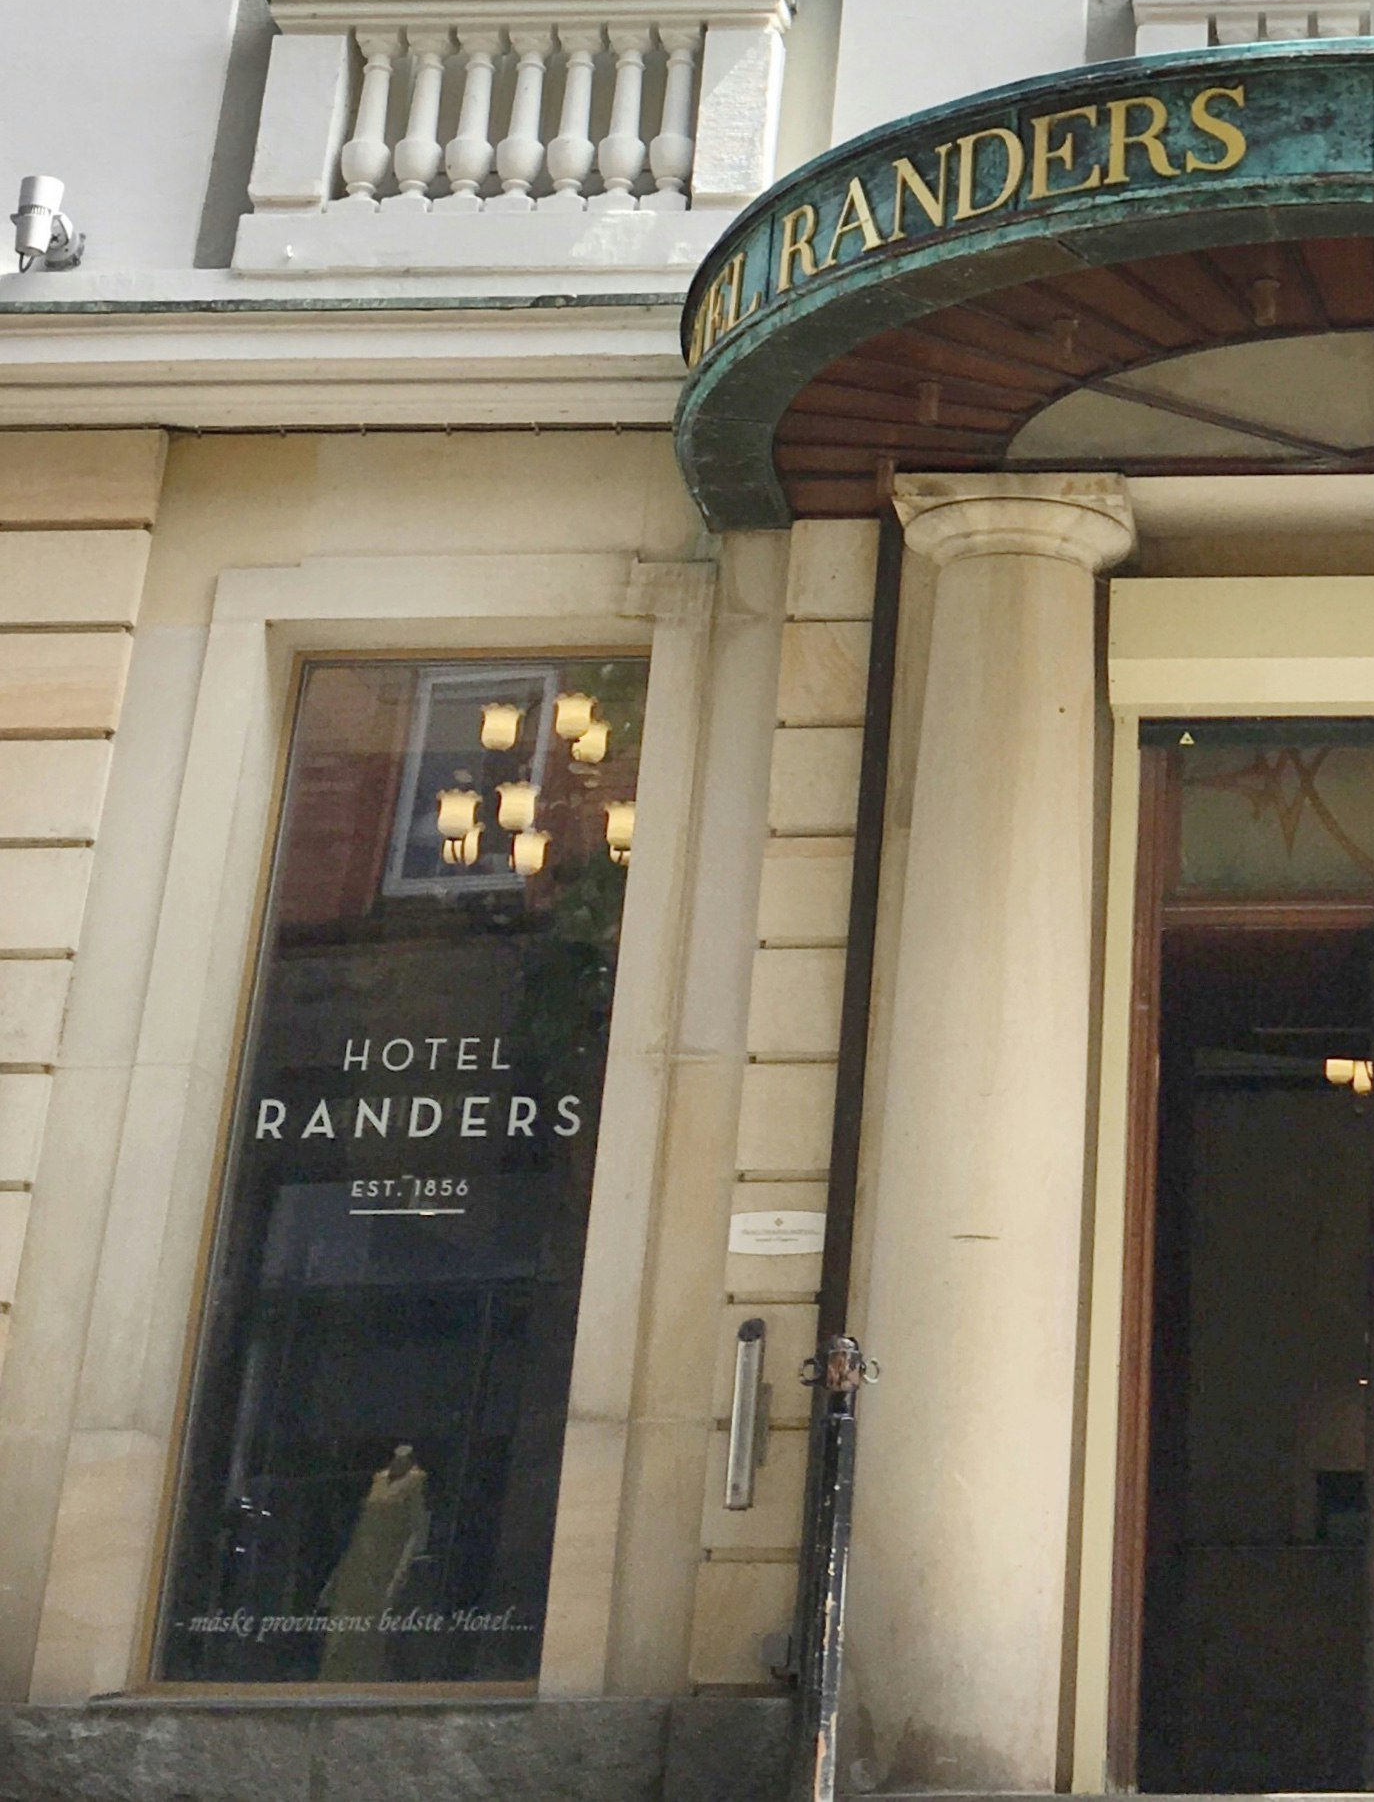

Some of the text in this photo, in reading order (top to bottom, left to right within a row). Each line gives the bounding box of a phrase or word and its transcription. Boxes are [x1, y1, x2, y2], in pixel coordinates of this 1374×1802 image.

[776, 83, 1248, 294] RANDERS
[343, 1037, 511, 1072] HOTEL
[254, 1094, 582, 1140] RANDERS
[350, 1178, 470, 1198] EST. 1856
[188, 1606, 255, 1639] måske
[257, 1607, 374, 1642] provinsens
[376, 1606, 444, 1633] bedste
